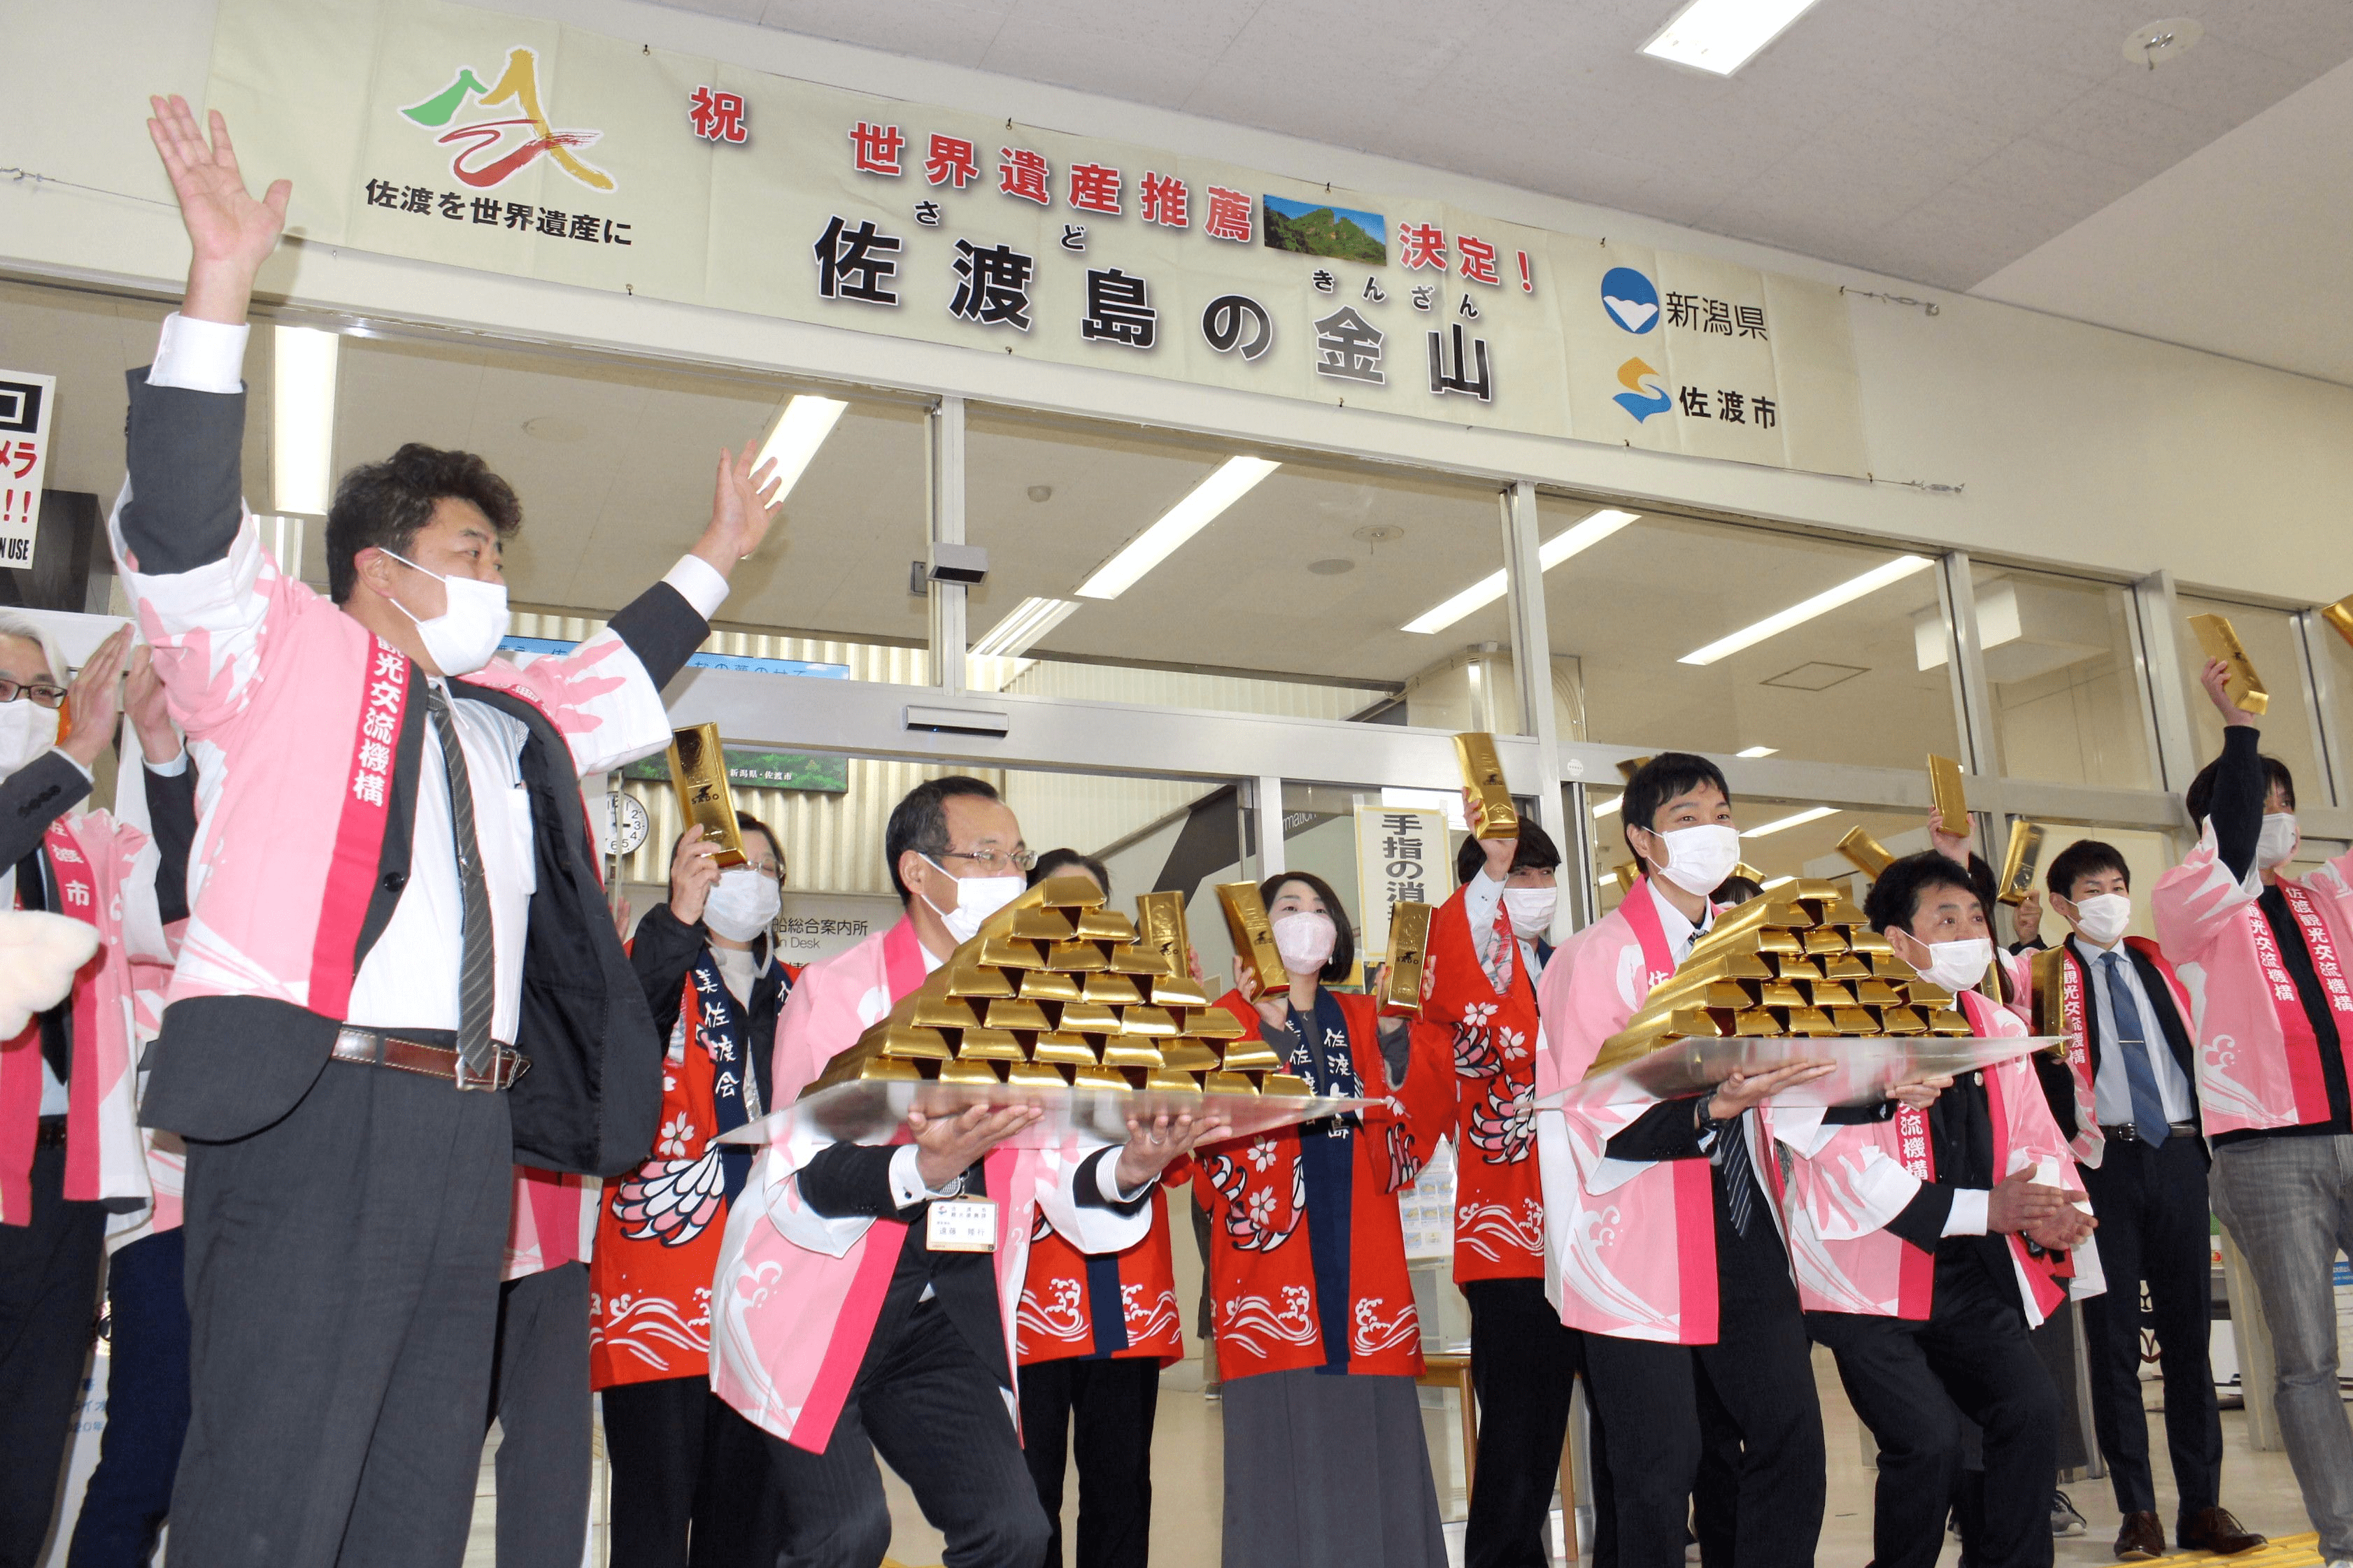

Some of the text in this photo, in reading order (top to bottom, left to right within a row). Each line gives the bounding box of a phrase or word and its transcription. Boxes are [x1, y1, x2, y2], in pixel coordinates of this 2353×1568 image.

[690, 85, 748, 143] 祝
[848, 121, 1253, 243] 世界遺産推薦
[366, 178, 633, 246] 佐渡を世界遺産に
[812, 215, 1493, 404] 佐渡島の金山
[1312, 268, 1479, 320] きんざん
[1666, 290, 1768, 341] 新潟県
[1679, 385, 1777, 429] 佐渡市
[8, 538, 29, 560] USE
[634, 821, 641, 830] 3
[791, 936, 820, 949] Desk
